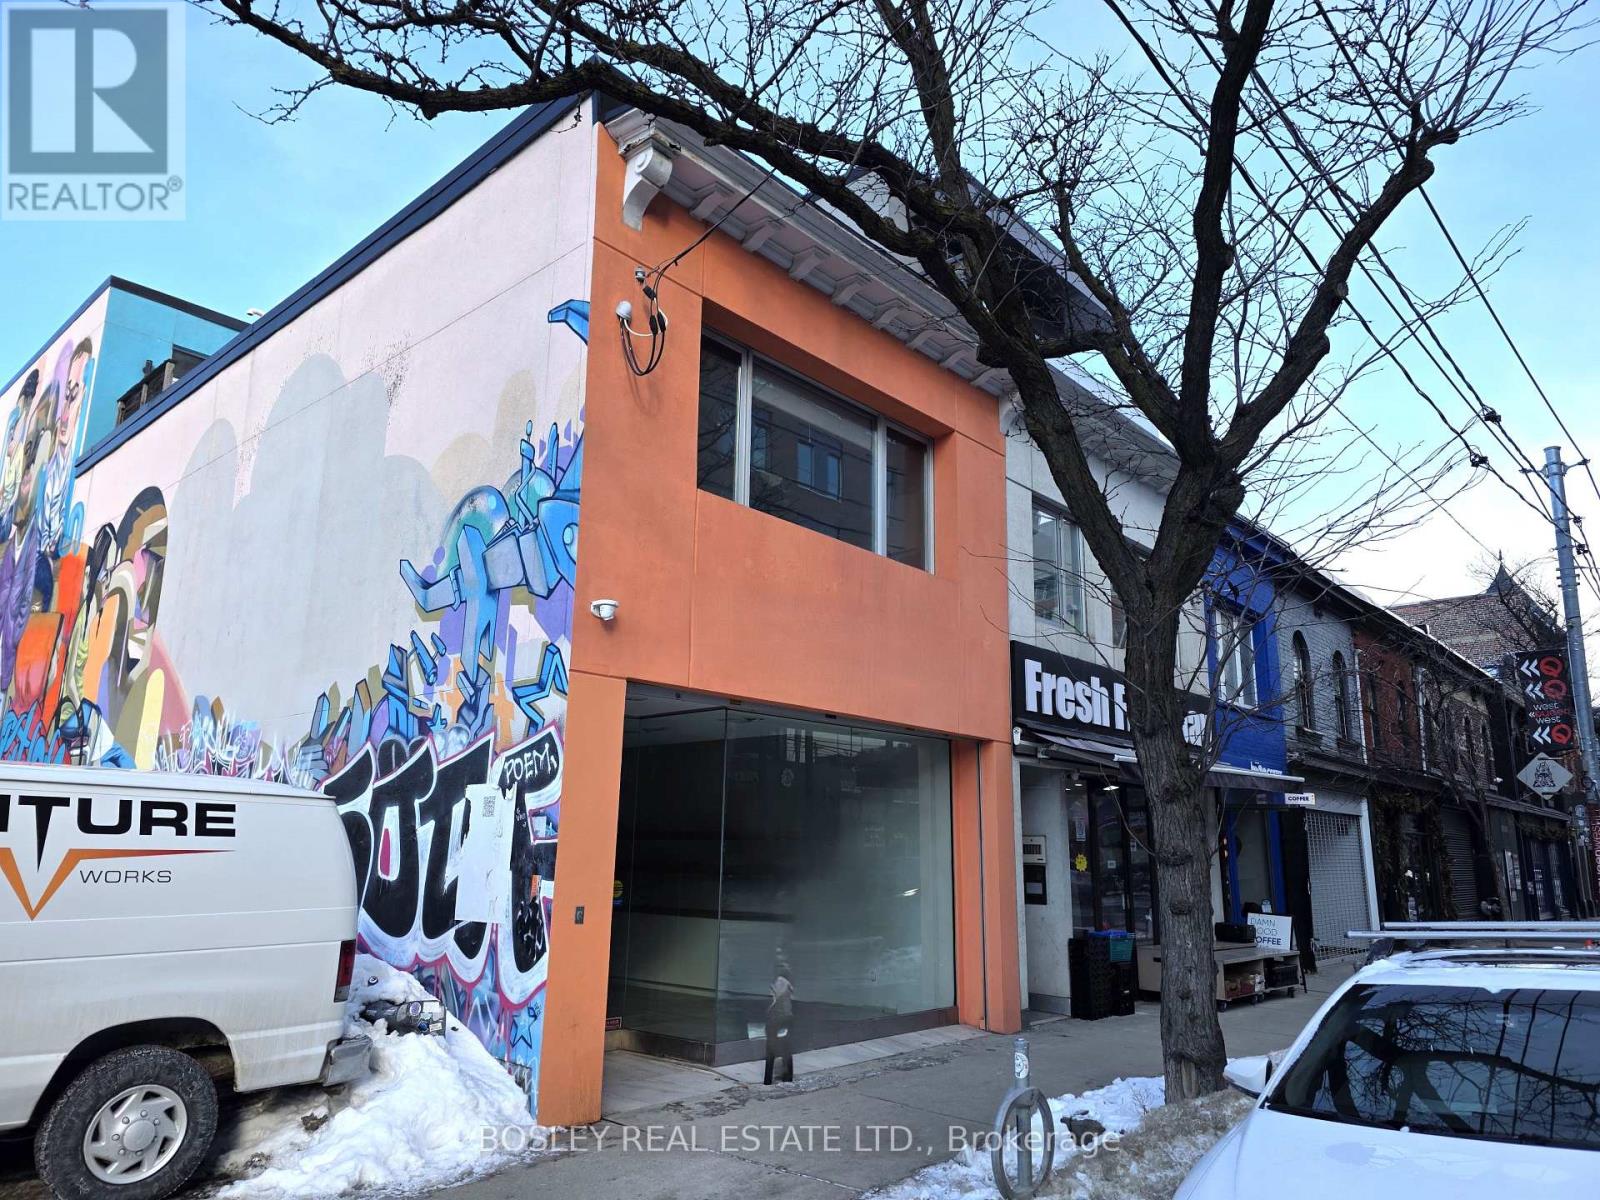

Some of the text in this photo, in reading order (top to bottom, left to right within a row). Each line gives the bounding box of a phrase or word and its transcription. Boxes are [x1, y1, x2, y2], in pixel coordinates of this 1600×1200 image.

[1024, 658, 1110, 728] Fresh
[79, 869, 172, 884] WORKS
[1250, 917, 1276, 927] DAMN
[1256, 927, 1279, 937] OOD
[1255, 935, 1283, 946] OFFEE
